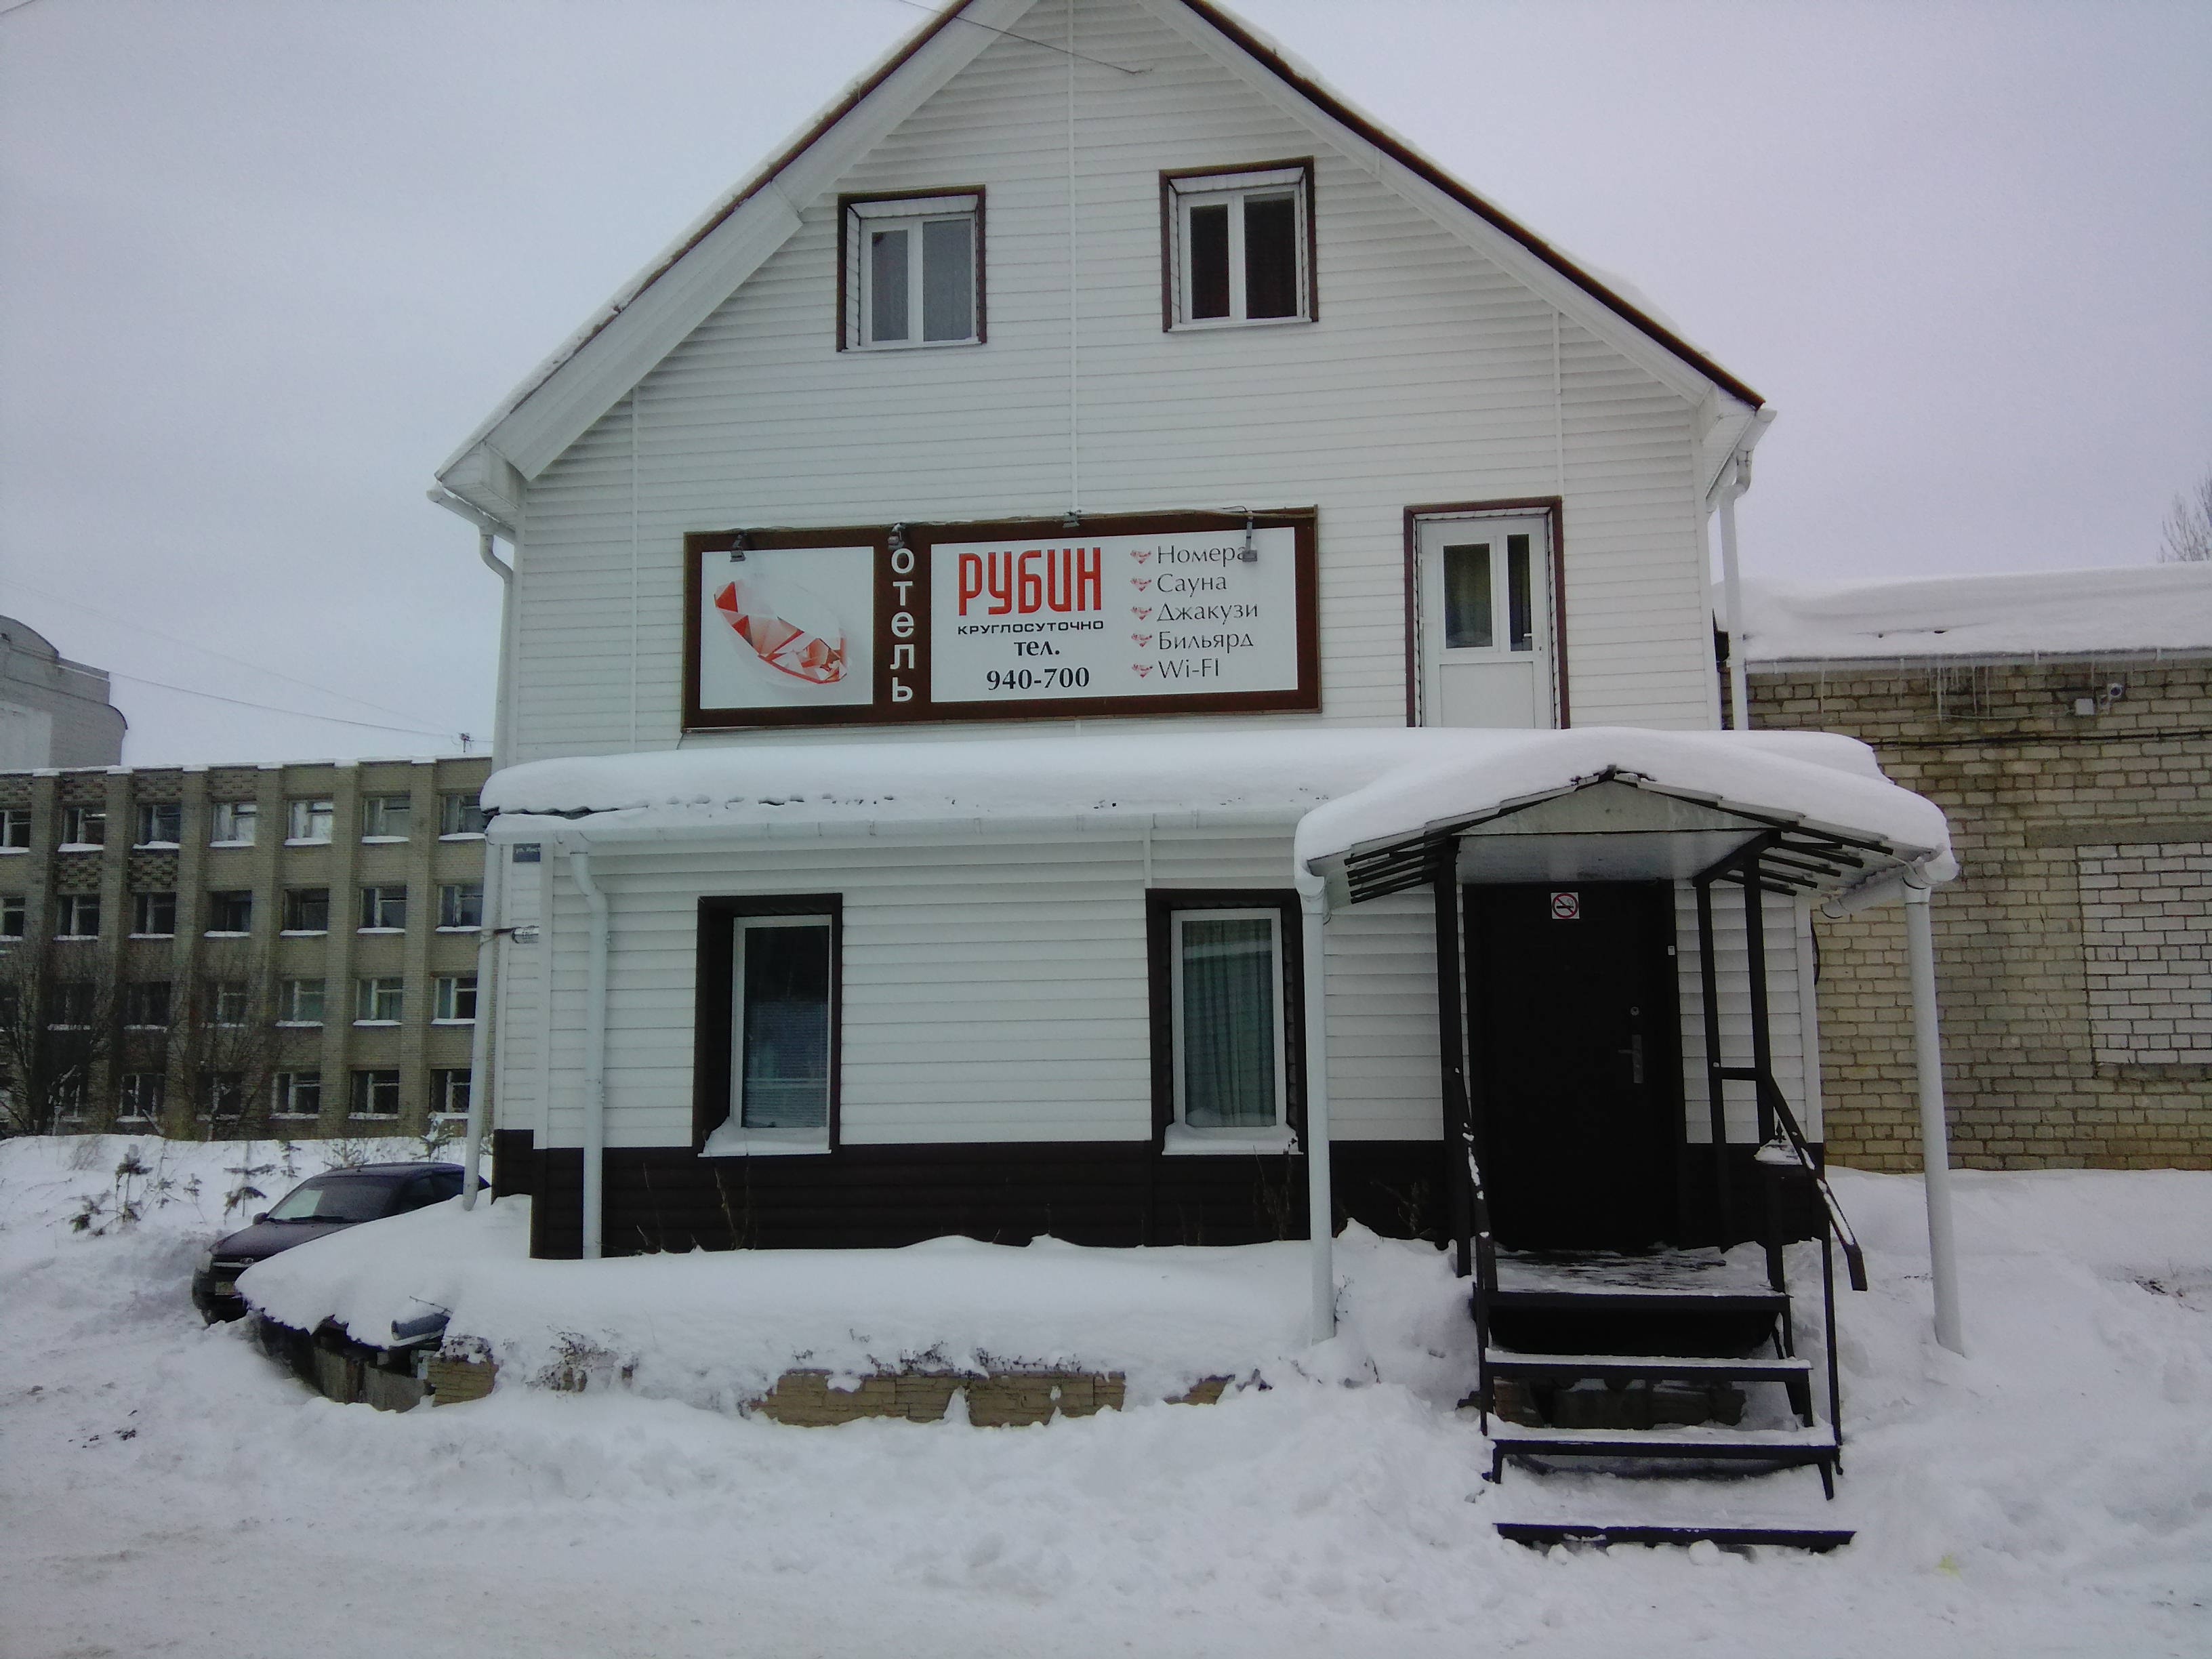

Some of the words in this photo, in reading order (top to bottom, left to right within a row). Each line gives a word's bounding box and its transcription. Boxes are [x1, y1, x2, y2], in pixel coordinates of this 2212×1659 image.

[958, 547, 1102, 616] РУБИН
[1157, 573, 1227, 598] Сауна
[890, 548, 914, 702] отель
[1157, 602, 1258, 625] Джакузи
[958, 621, 1104, 635] КРУГЛОСУТОЧНО
[1014, 641, 1060, 656] тел.
[1160, 631, 1254, 653] Бильярд
[986, 667, 1090, 691] 940-700
